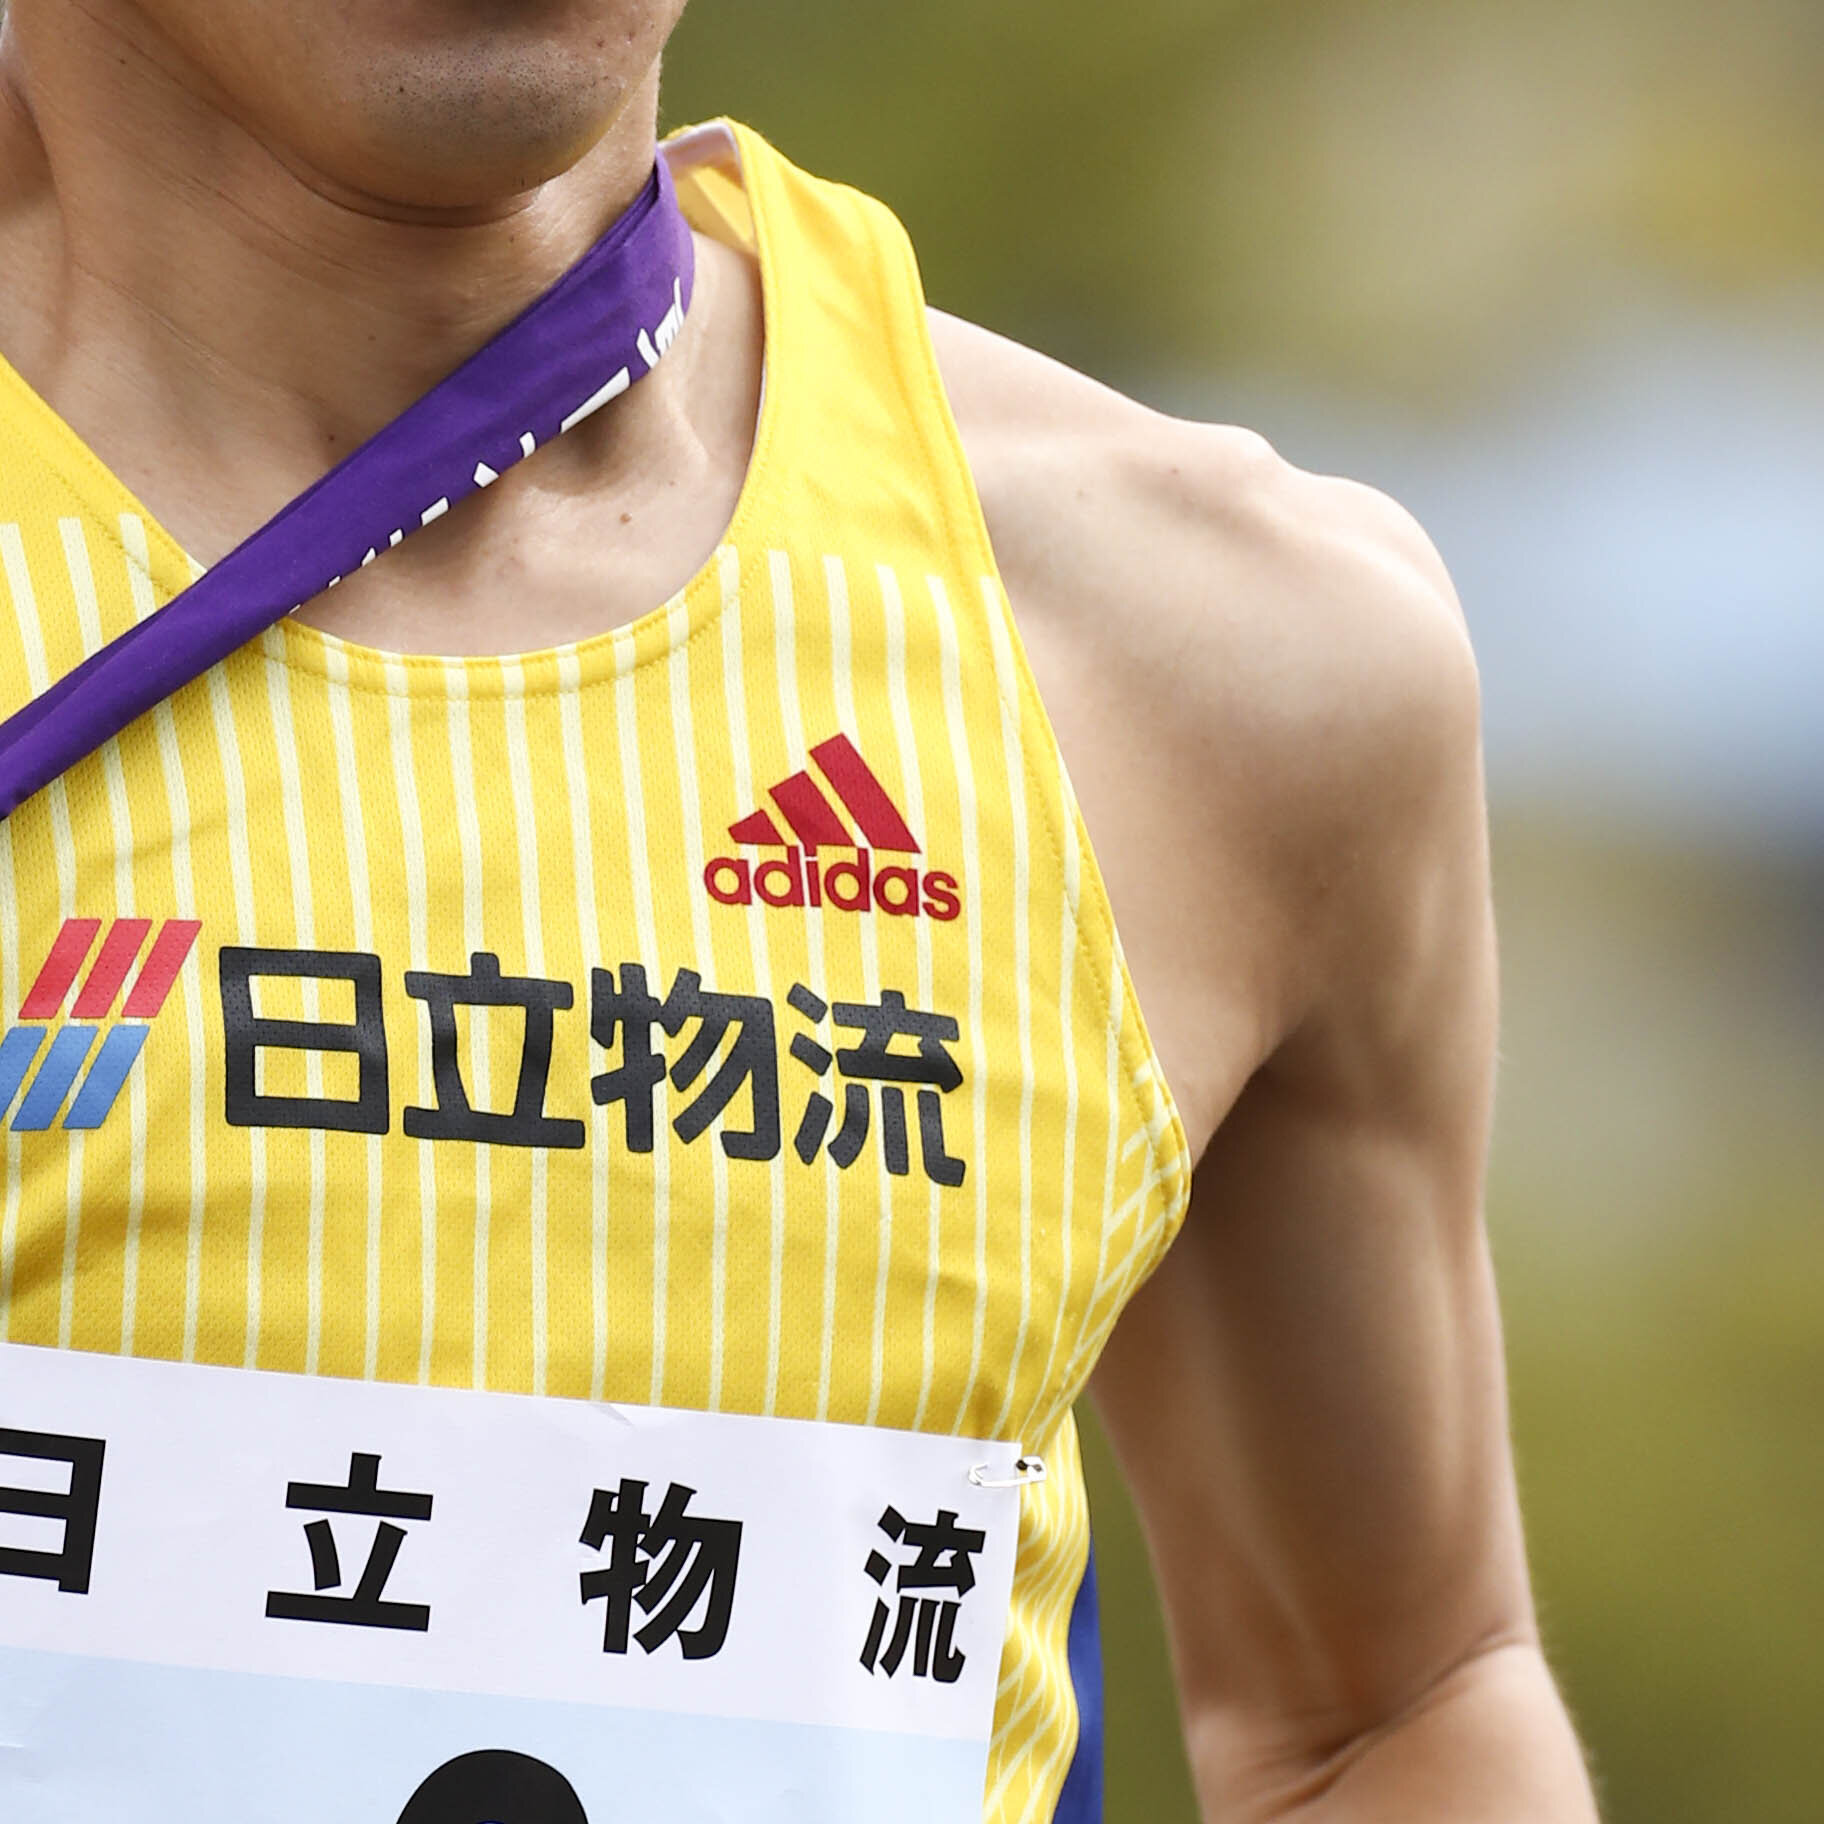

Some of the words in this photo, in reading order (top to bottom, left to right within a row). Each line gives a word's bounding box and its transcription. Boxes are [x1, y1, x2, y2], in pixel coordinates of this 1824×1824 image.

[703, 845, 961, 921] adidas
[218, 946, 966, 1188] 日立物流
